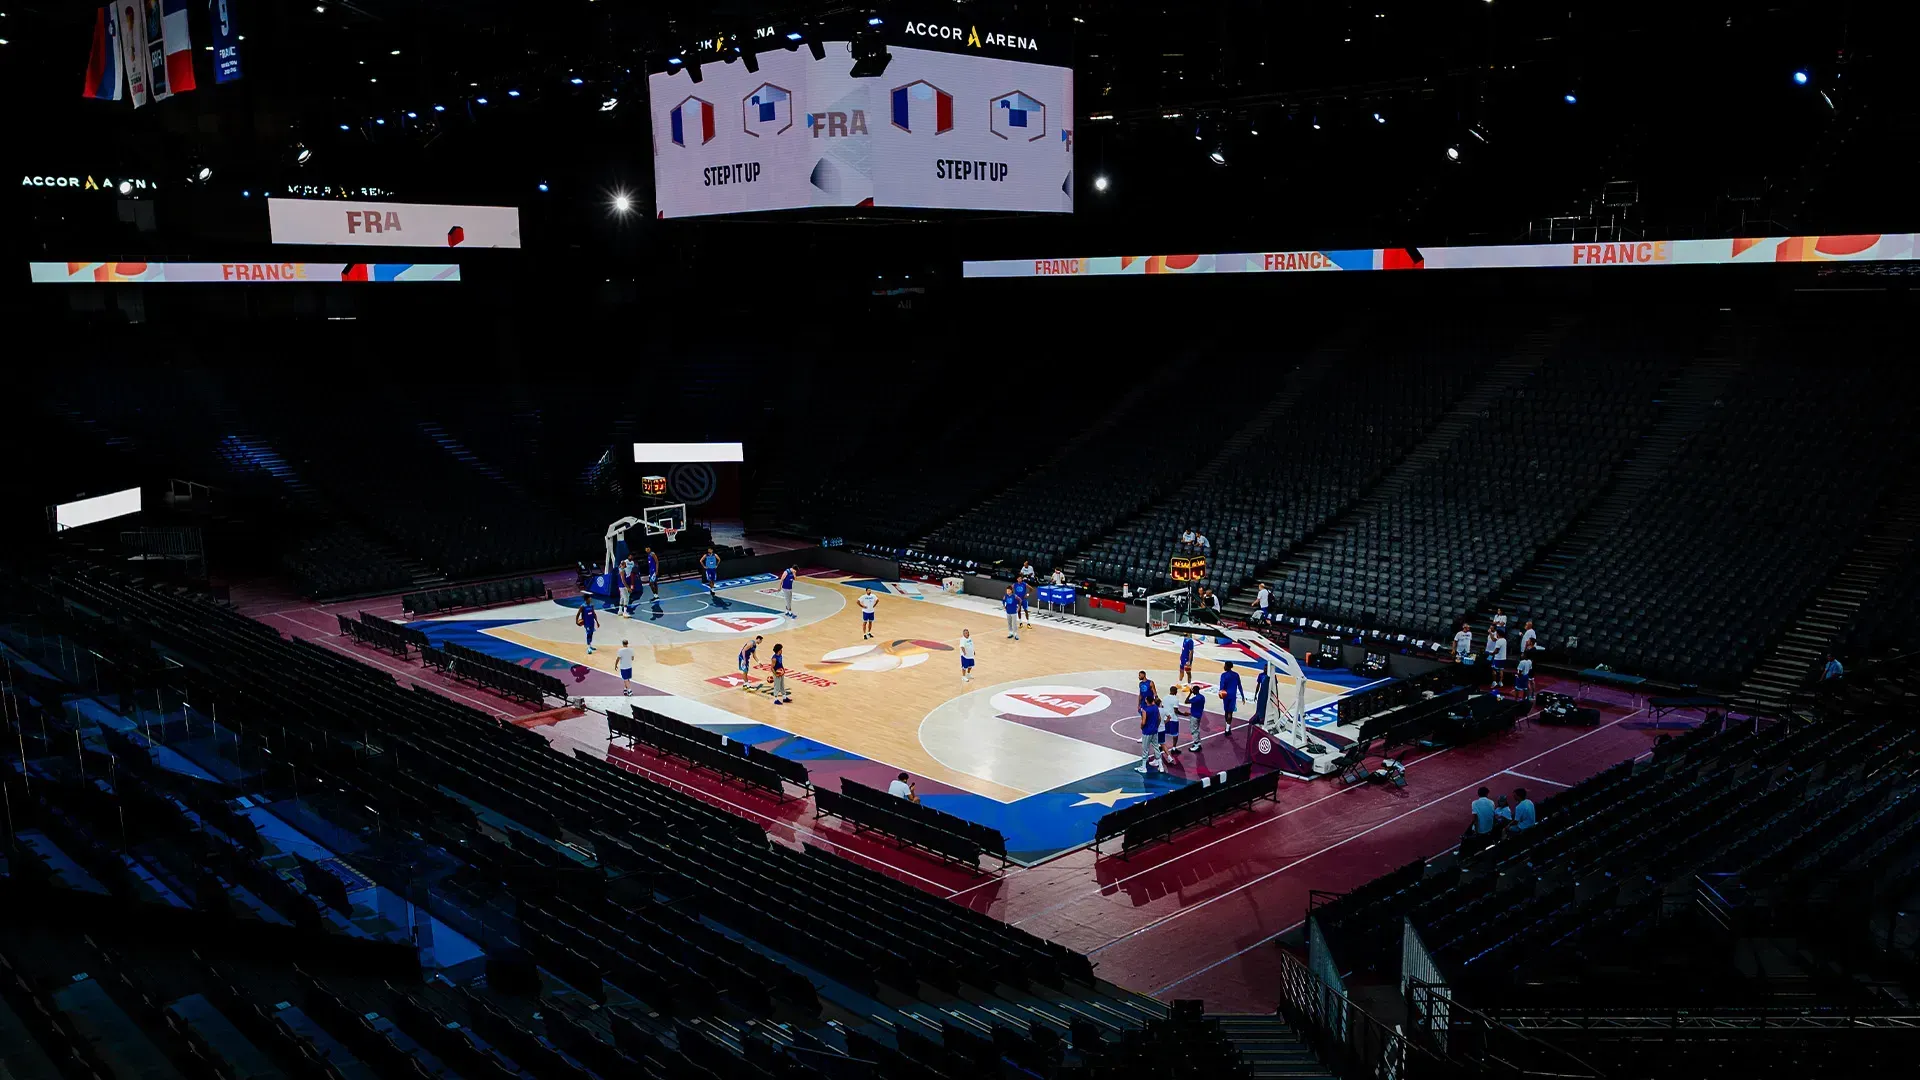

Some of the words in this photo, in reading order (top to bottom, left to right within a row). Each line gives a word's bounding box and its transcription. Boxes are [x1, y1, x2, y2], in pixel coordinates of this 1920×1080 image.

[905, 21, 962, 40] ACCOR
[985, 32, 1038, 51] ARENA
[812, 109, 868, 139] FRA
[22, 176, 80, 187] ACCOR
[703, 164, 731, 187] STEP
[732, 163, 743, 184] IT
[744, 162, 761, 183] UP
[936, 159, 972, 180] STEP
[974, 161, 987, 181] IT
[989, 162, 1008, 182] UP
[346, 210, 402, 234] FRA
[1264, 251, 1332, 270] FRANCE
[1573, 240, 1667, 264] FRANCE
[222, 262, 307, 280] FRANCE
